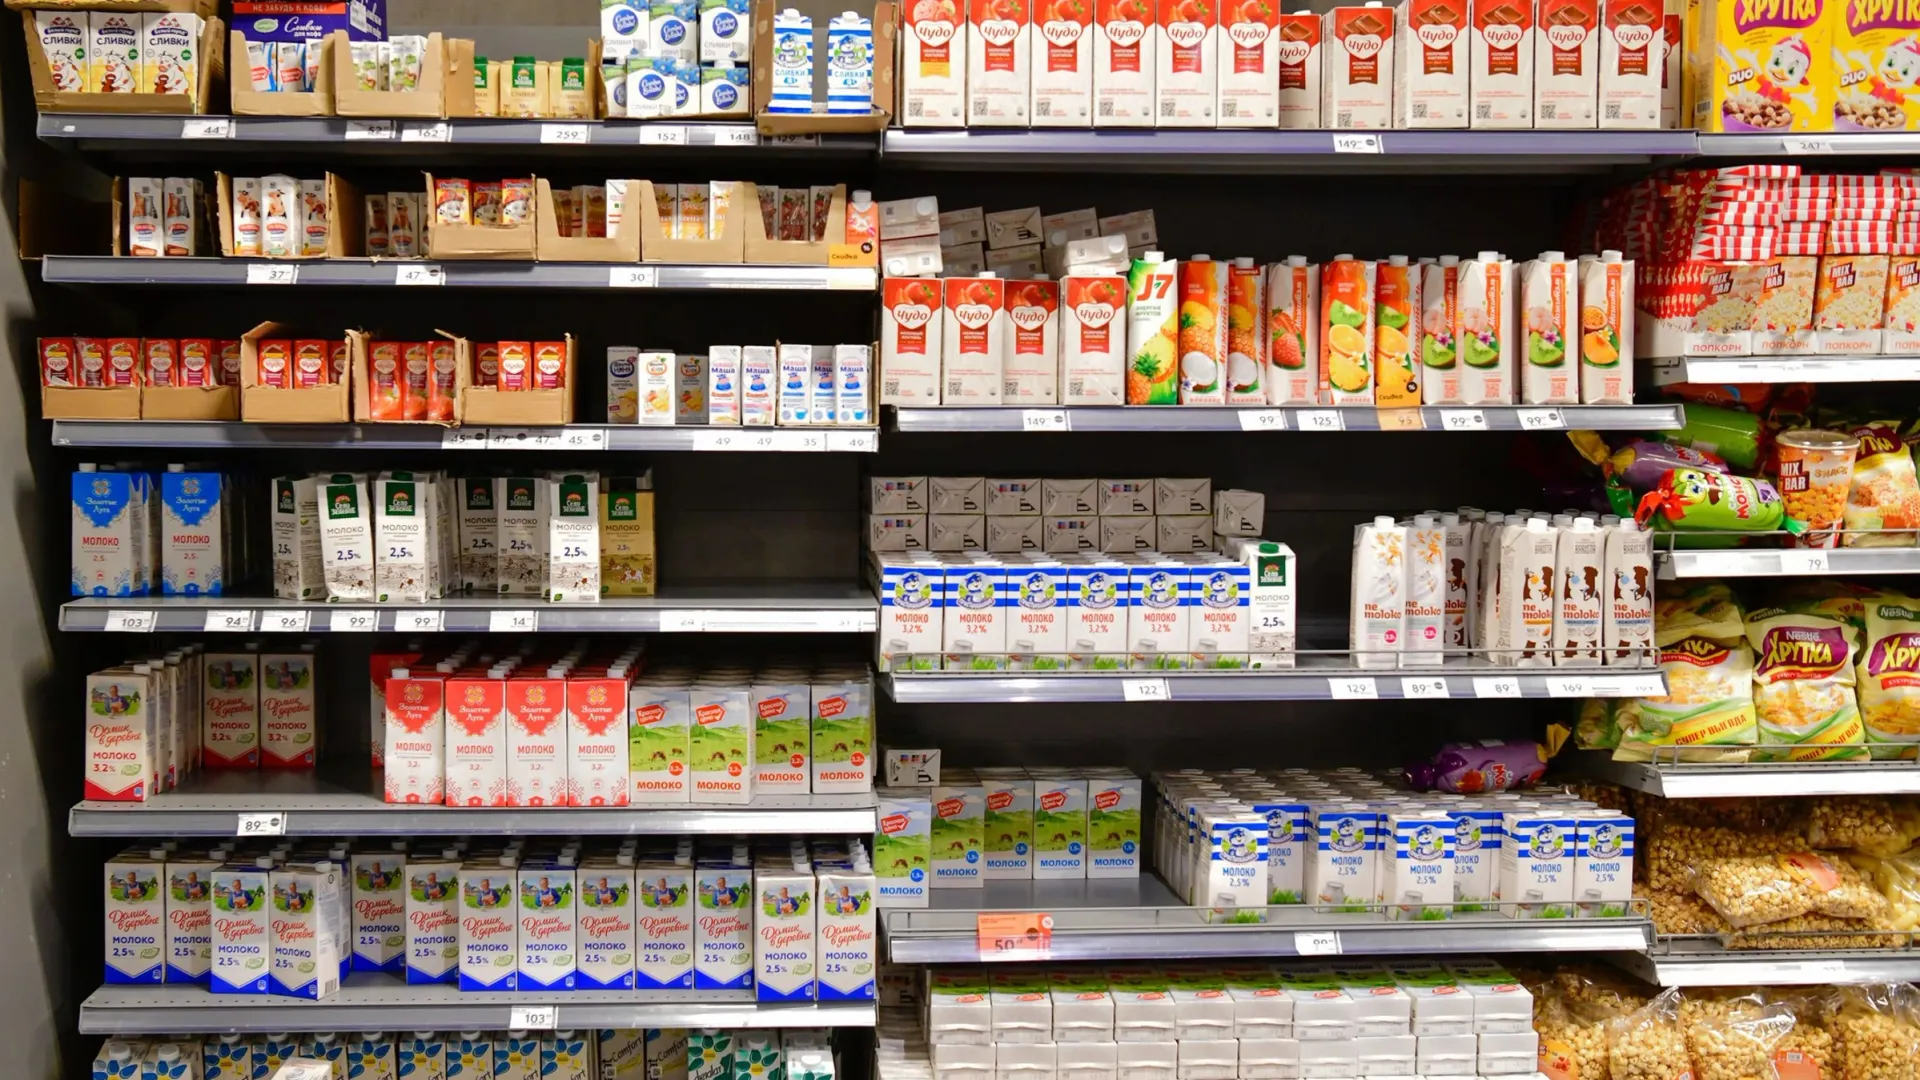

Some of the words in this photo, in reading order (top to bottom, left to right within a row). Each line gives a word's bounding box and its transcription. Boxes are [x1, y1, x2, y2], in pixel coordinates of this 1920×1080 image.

[252, 4, 262, 12] НЕ
[264, 4, 294, 12] ЗАБУДЬ
[919, 26, 951, 40] Чудо
[984, 26, 1015, 40] Чудо
[1046, 27, 1079, 41] Чудо
[1422, 29, 1454, 43] Чудо
[1618, 29, 1650, 43] Чудо
[43, 36, 82, 46] СЛИВКИ
[97, 37, 136, 46] СЛИВКИ
[150, 37, 189, 47] СЛИВКИ
[1348, 40, 1379, 53] Чудо
[1728, 69, 1755, 86] DUO
[1840, 70, 1867, 87] DUO
[204, 125, 219, 135] 44
[556, 131, 579, 140] 259
[657, 133, 677, 141] 152
[730, 133, 751, 141] 148
[269, 270, 284, 280] 37
[1832, 263, 1850, 278] MIX
[405, 271, 420, 281] 47
[630, 273, 645, 282] 30
[1708, 272, 1730, 288] MIX
[1836, 275, 1854, 288] BAR
[1711, 280, 1732, 295] BAR
[896, 310, 928, 323] Чудо
[1015, 311, 1045, 324] Чудо
[1079, 309, 1111, 321] Чудо
[1692, 342, 1742, 353] ПОПКОРН
[1762, 340, 1809, 350] ПОПКОРН
[1825, 340, 1872, 351] ПОПКОРН
[711, 366, 736, 374] Маша
[746, 366, 771, 374] Маша
[840, 365, 865, 373] Маша
[715, 437, 731, 446] 49
[757, 436, 772, 446] 49
[803, 438, 817, 447] 35
[849, 438, 865, 447] 49
[1780, 462, 1800, 476] MIX
[1784, 476, 1806, 490] BAR
[504, 517, 538, 525] МОЛОКО
[327, 525, 364, 535] МОЛОКО
[382, 524, 419, 532] МОЛОКО
[557, 524, 593, 532] МОЛОКО
[606, 524, 640, 532] МОЛОКО
[82, 536, 119, 546] МОЛОКО
[173, 535, 210, 544] МОЛОКО
[472, 539, 494, 549] 2,5%
[511, 540, 532, 550] 2,5%
[337, 550, 361, 561] 2,5%
[390, 547, 413, 557] 2,5%
[564, 546, 587, 557] 2,5%
[1364, 603, 1378, 611] ne
[1364, 605, 1402, 619] moloko
[1563, 603, 1576, 611] ne
[1614, 603, 1628, 611] ne
[895, 613, 929, 623] МОЛОКО
[959, 613, 993, 623] МОЛОКО
[1021, 613, 1054, 623] МОЛОКО
[1204, 613, 1237, 623] МОЛОКО
[1563, 607, 1600, 619] moloko
[1614, 607, 1651, 619] moloko
[121, 618, 143, 627] 103
[225, 616, 241, 626] 94
[281, 617, 297, 627] 96
[350, 617, 366, 627] 99
[414, 617, 431, 627] 99
[1262, 617, 1285, 627] 2,5%
[902, 624, 923, 634] 3,2%
[967, 624, 987, 634] 3,2%
[1028, 624, 1048, 634] 3,2%
[1766, 631, 1833, 668] ХРУТКА
[1138, 685, 1158, 695] 122
[1347, 684, 1366, 693] 129
[1412, 683, 1427, 693] 89
[1495, 683, 1509, 693] 89
[459, 705, 491, 714] Золотые
[466, 713, 484, 722] Луга
[211, 721, 250, 730] МОЛОКО
[267, 721, 307, 730] МОЛОКО
[1675, 727, 1707, 747] СУПЕР
[1707, 713, 1747, 736] ВЫГОДА
[89, 723, 132, 740] Домик
[456, 745, 494, 755] МОЛОКО
[578, 744, 616, 754] МОЛОКО
[93, 751, 137, 760] МОЛОКО
[93, 763, 116, 773] 3,2%
[820, 771, 864, 781] МОЛОКО
[637, 781, 683, 790] МОЛОКО
[245, 821, 262, 831] 89
[1040, 858, 1080, 868] МОЛОКО
[1589, 863, 1620, 873] МОЛОКО
[1222, 866, 1256, 877] МОЛОКО
[1229, 877, 1250, 887] 2,5%
[1596, 873, 1615, 883] 2,5%
[880, 886, 923, 896] МОЛОКО
[108, 908, 149, 925] Домик
[760, 923, 800, 941] Домик
[112, 935, 155, 944] МОЛОКО
[113, 947, 135, 957] 2,5%
[526, 943, 567, 952] МОЛОКО
[765, 952, 807, 960] МОЛОКО
[765, 963, 787, 973] 2,5%
[525, 1014, 545, 1023] 103
